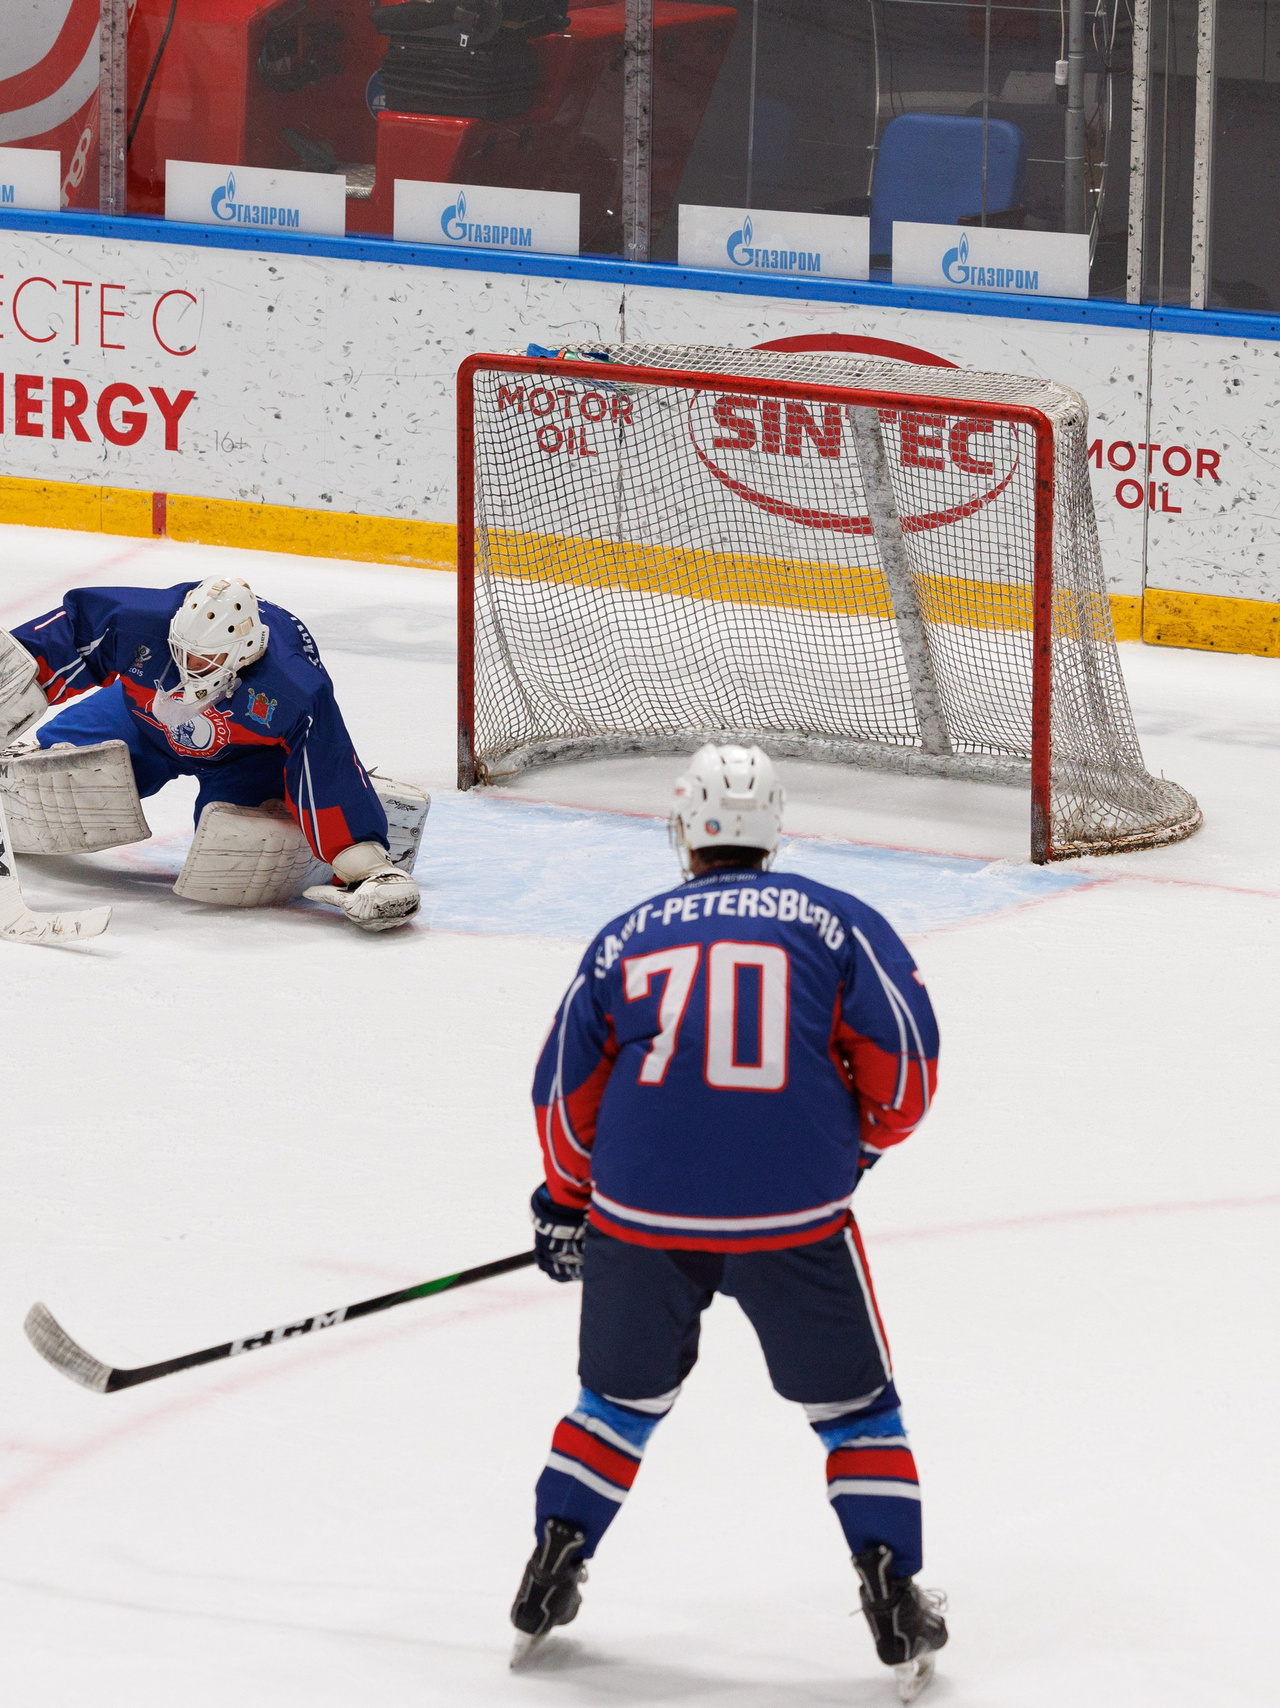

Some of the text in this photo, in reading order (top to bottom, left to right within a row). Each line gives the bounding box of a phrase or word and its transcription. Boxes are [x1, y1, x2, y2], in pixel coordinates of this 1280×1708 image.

[237, 204, 300, 228] ГАЗПРОМ
[468, 223, 532, 247] ГАЗПРОМ
[754, 248, 821, 272] ГАЗПРОМ
[970, 266, 1039, 290] ГАЗПРОМ
[152, 289, 198, 356] С
[497, 383, 634, 426] MOTOR
[214, 430, 248, 453] 16+
[537, 424, 598, 458] OIL
[1115, 478, 1182, 514] OIL
[621, 938, 791, 1094] 70
[228, 1306, 349, 1357] CCM
